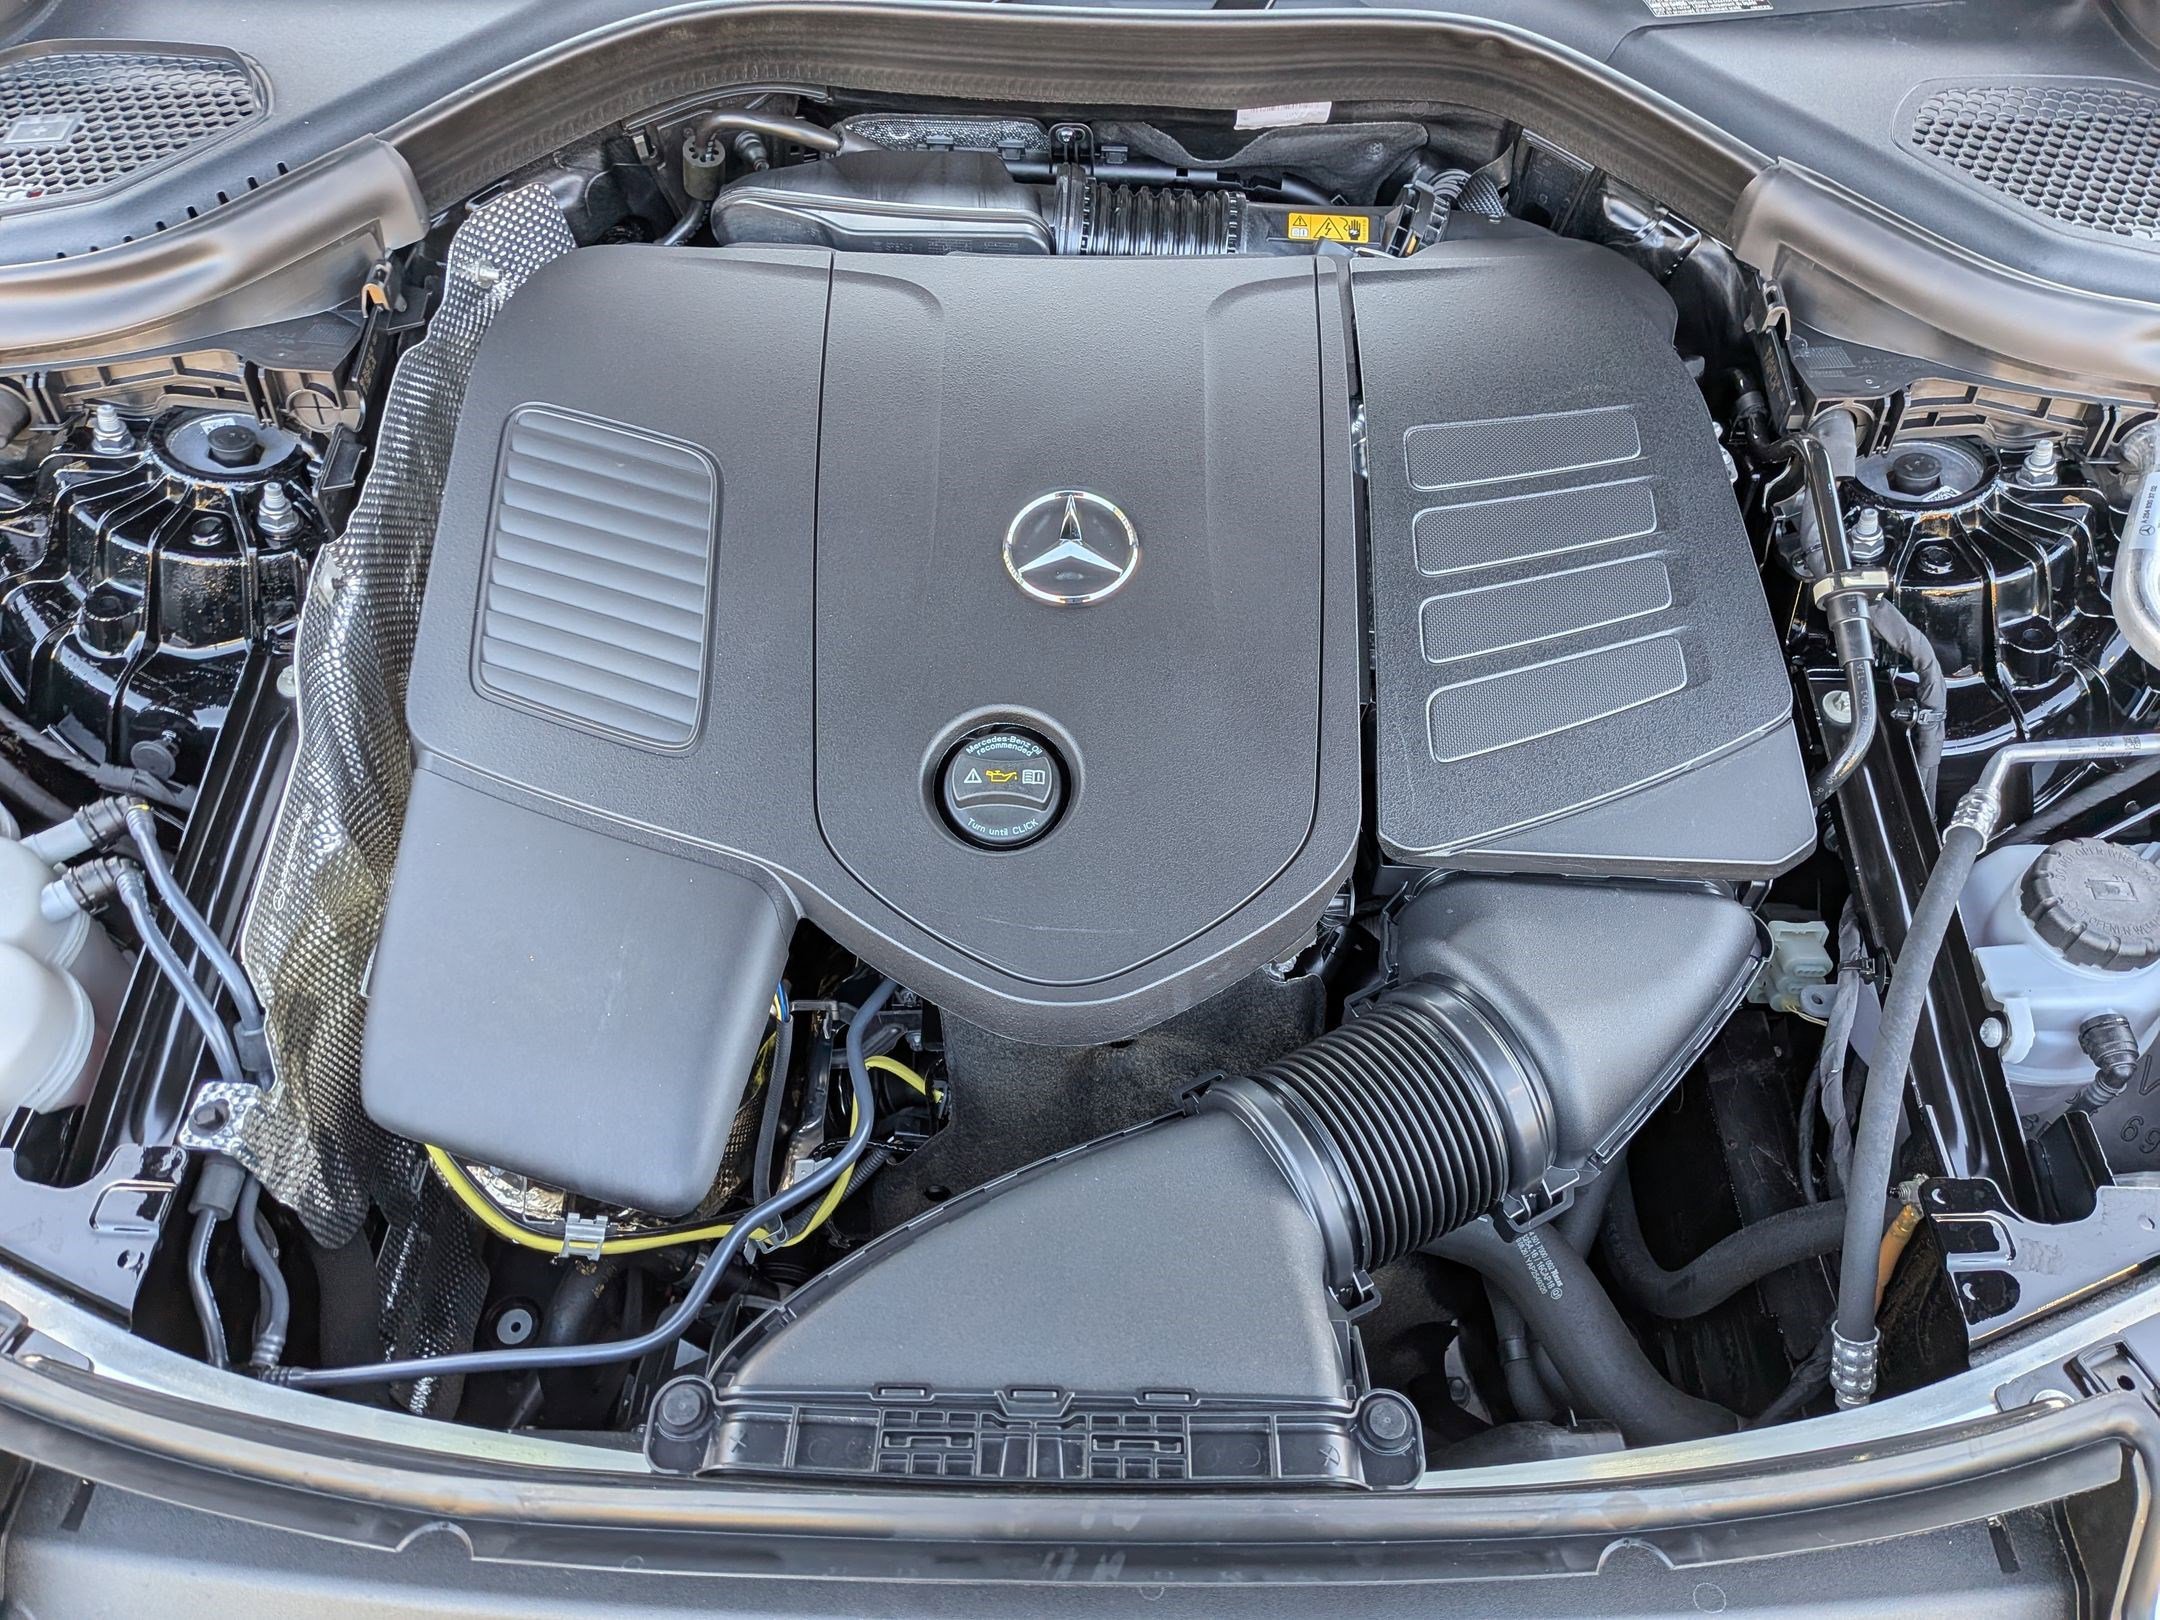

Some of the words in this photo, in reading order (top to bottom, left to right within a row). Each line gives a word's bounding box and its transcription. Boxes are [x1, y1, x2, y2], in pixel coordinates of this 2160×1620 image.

[966, 736, 1031, 754] Mercedes-Benz
[1031, 745, 1043, 755] Oil
[976, 742, 1034, 757] recommended
[967, 817, 986, 833] Turn
[988, 828, 1009, 836] until
[1012, 818, 1039, 835] CLICK
